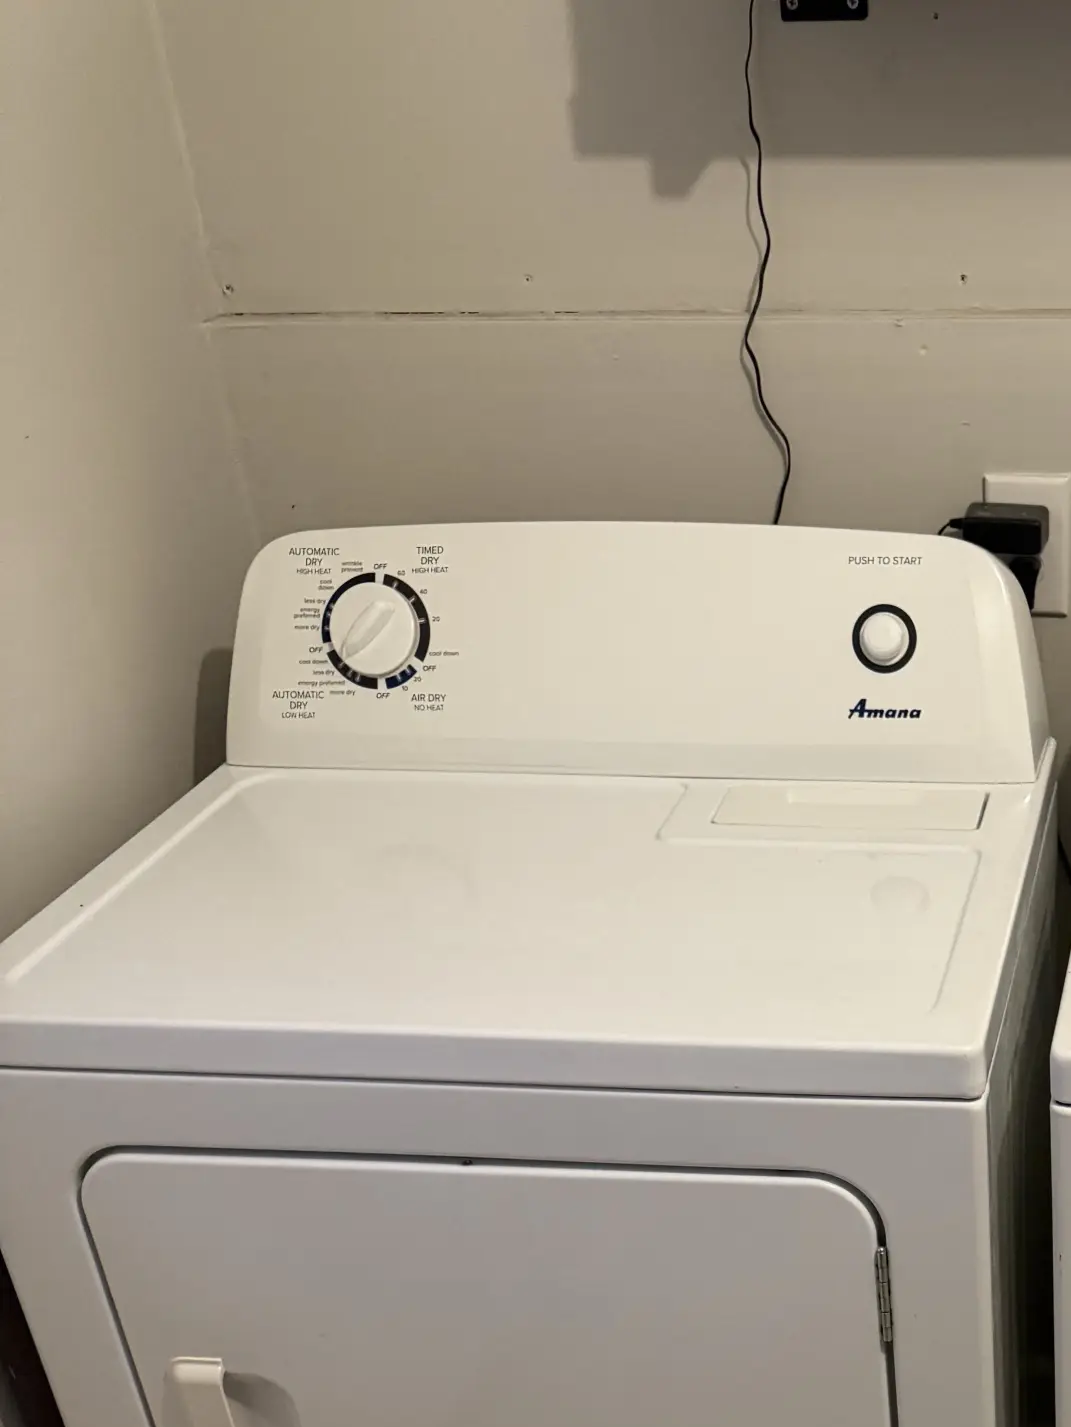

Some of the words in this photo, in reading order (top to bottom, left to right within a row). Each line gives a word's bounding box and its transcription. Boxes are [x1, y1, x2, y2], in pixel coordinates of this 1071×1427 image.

[289, 548, 340, 556] AUTOMATIC
[416, 546, 444, 554] TIMED
[305, 558, 323, 566] DRY
[420, 557, 439, 565] DRY
[848, 556, 874, 565] PUSH
[877, 556, 890, 565] TO
[893, 556, 923, 565] START
[272, 690, 324, 699] AUTOMATIC
[428, 694, 446, 702] DRY
[289, 701, 308, 709] DRY
[848, 698, 921, 719] Amana
